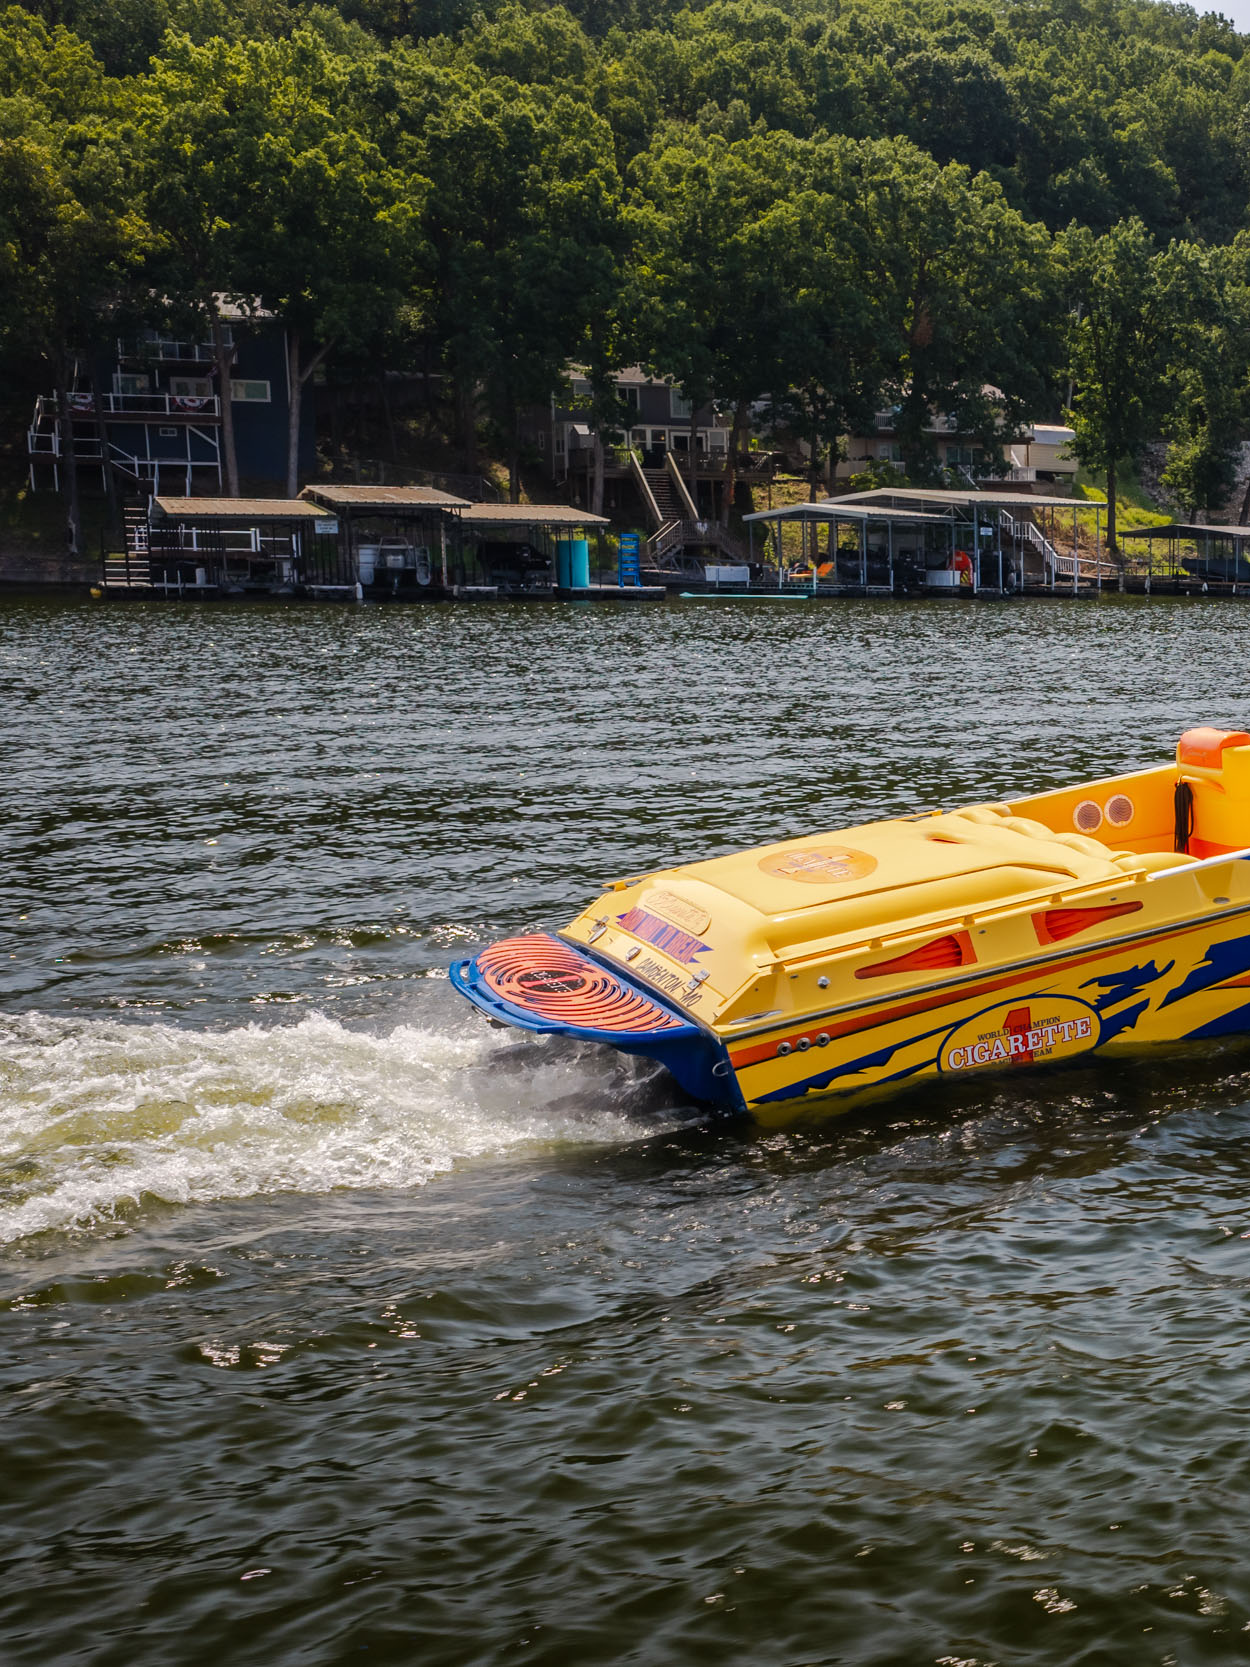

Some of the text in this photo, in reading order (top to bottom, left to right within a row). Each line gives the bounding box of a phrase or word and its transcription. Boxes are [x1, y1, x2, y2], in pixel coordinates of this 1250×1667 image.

[977, 1016, 1061, 1041] WORLD CHAMPION
[948, 1016, 1091, 1069] CIGARETTE
[1029, 1047, 1052, 1059] TEAM
